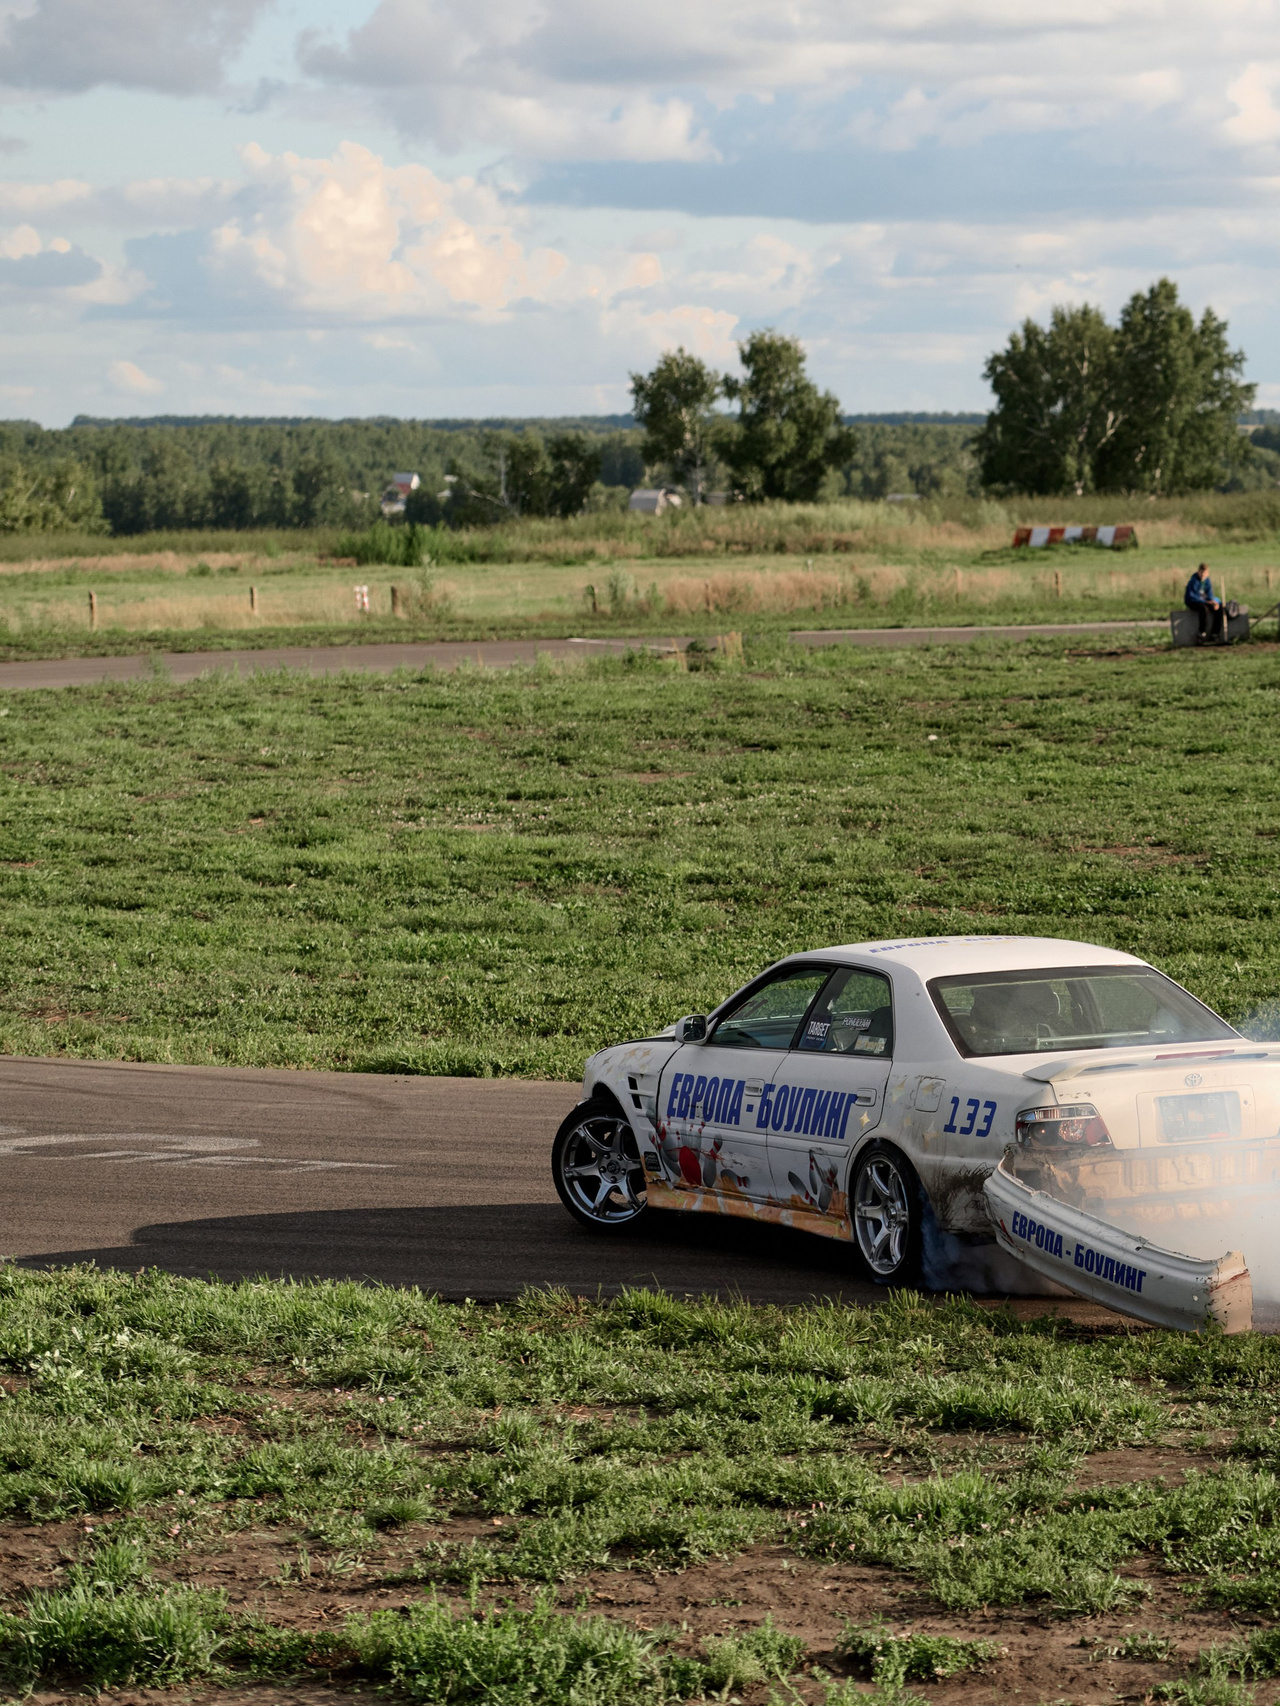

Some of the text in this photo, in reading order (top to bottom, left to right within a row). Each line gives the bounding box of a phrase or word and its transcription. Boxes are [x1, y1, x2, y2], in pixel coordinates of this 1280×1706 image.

[807, 1021, 831, 1037] TARGET
[666, 1072, 746, 1126] ЕВРОПА
[756, 1083, 858, 1140] БОУЛИНГ
[943, 1096, 997, 1137] 133
[1012, 1210, 1063, 1259] ЕВРОПА
[1074, 1243, 1147, 1293] БОУЛИНГ
